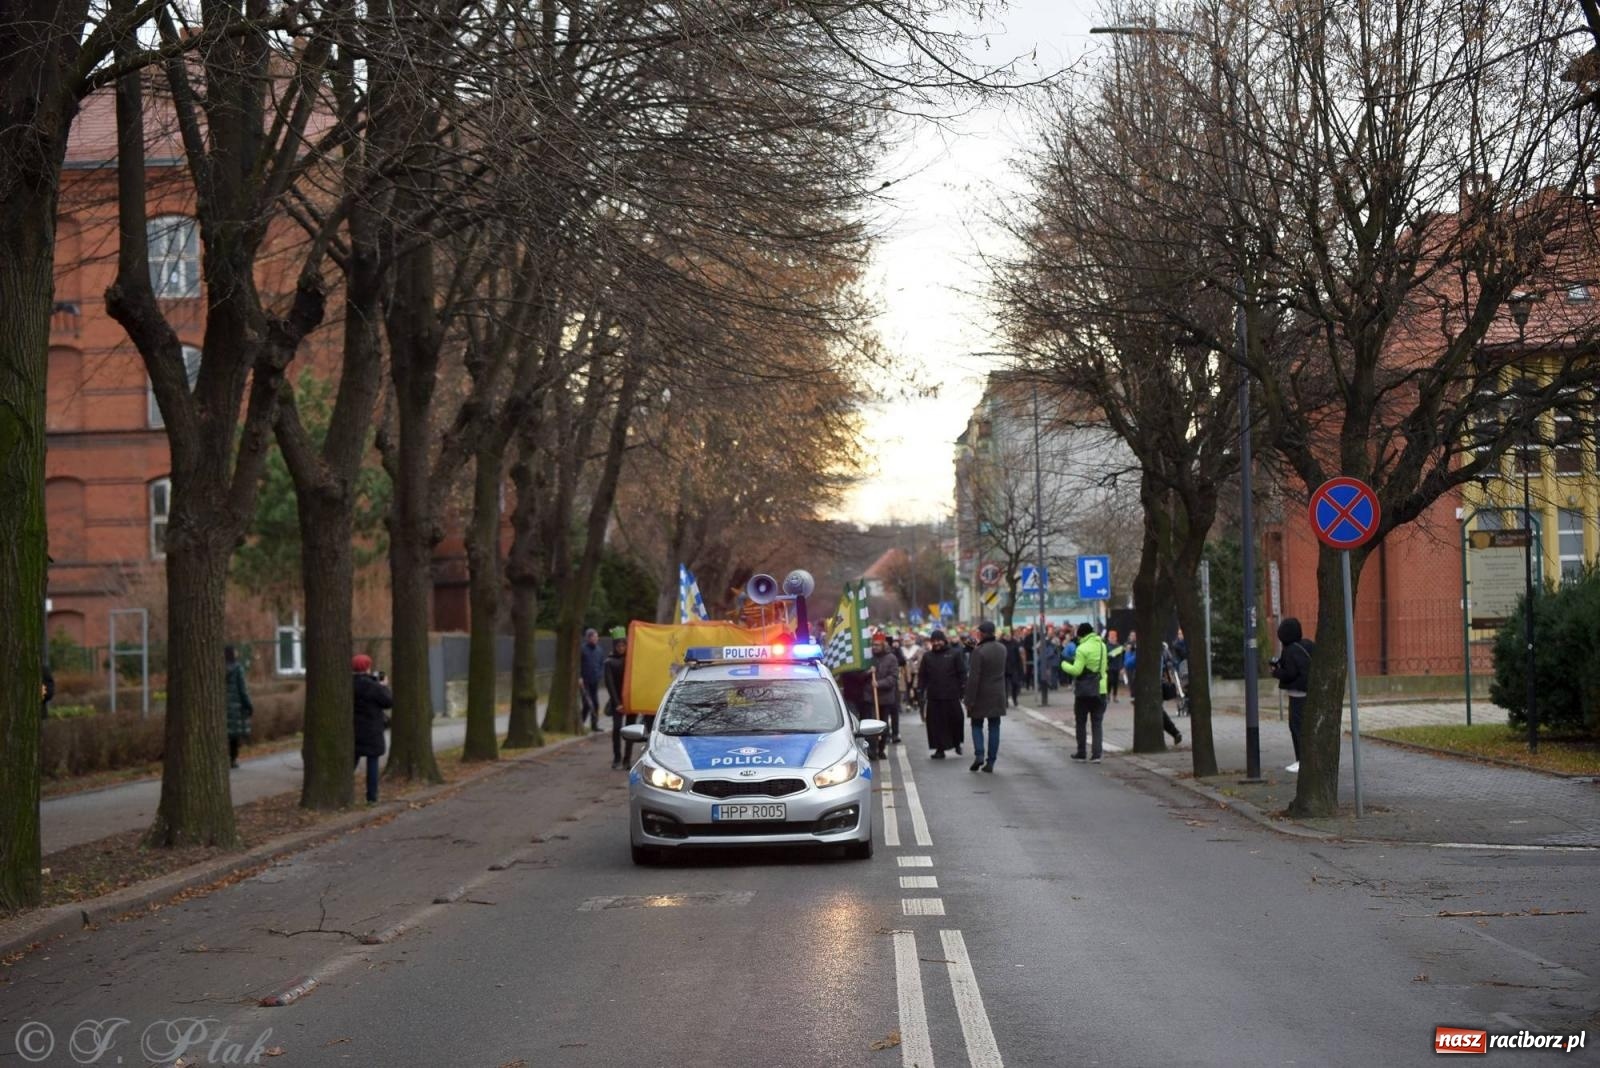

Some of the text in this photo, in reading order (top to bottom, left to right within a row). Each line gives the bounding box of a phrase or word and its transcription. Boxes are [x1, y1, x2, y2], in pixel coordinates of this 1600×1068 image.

[1084, 559, 1103, 587] P
[725, 648, 768, 658] POLICJA
[711, 756, 785, 766] POLICJA
[720, 805, 784, 819] HPP R005
